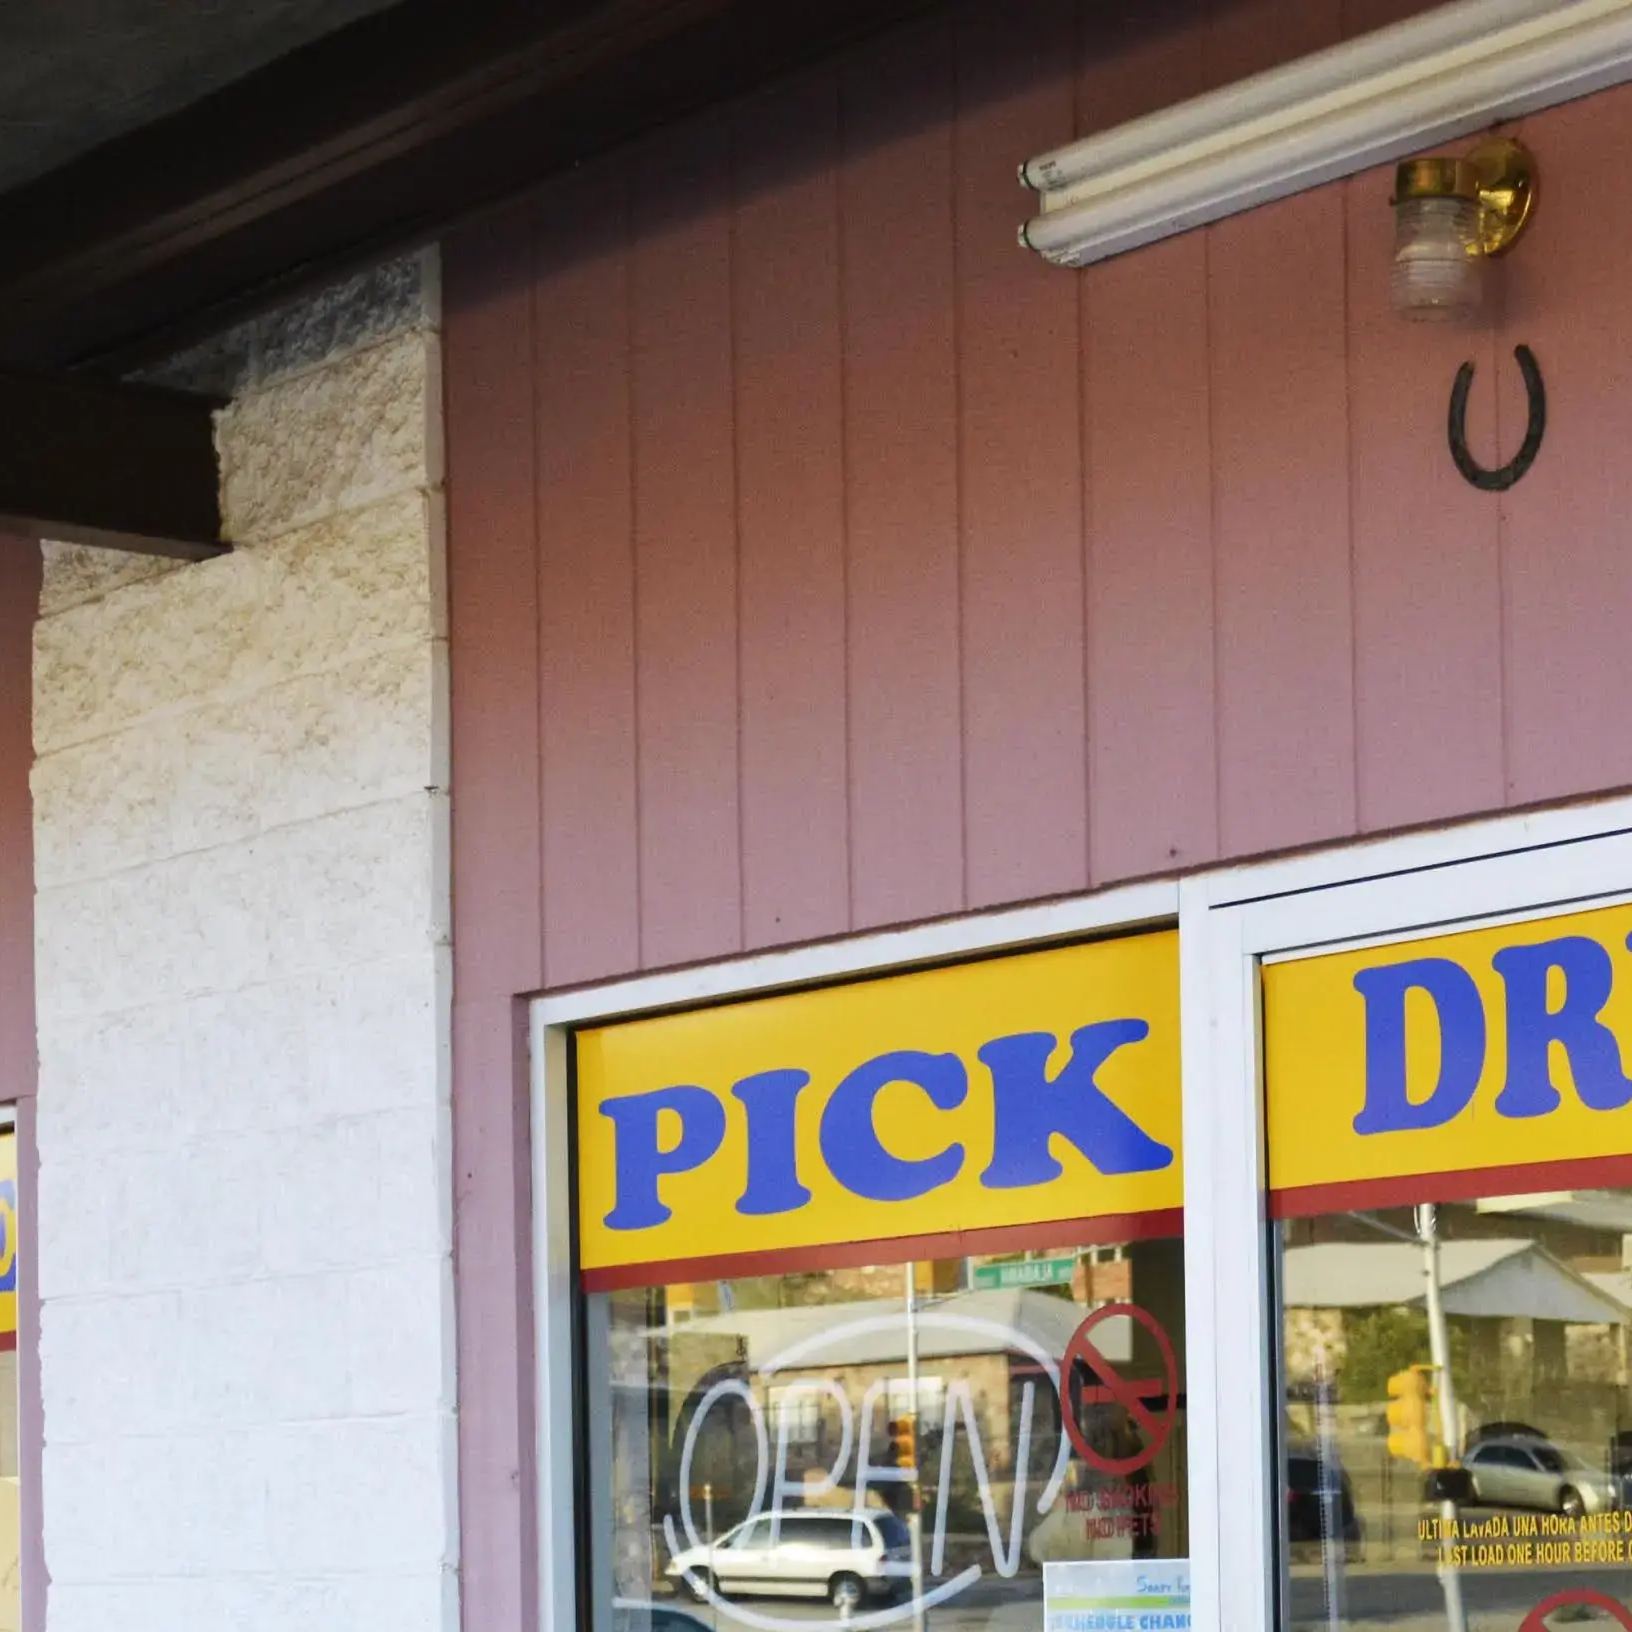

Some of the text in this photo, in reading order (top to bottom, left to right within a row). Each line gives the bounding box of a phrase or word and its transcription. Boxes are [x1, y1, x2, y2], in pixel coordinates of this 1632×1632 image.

[598, 1018, 1173, 1231] PICK
[680, 1378, 1034, 1578] OPEN
[1513, 1515, 1538, 1536] UNA
[1541, 1513, 1575, 1536] HORA
[1579, 1511, 1619, 1534] ANTES
[1438, 1543, 1466, 1567] LAST
[1471, 1543, 1504, 1566] LOAD
[1507, 1542, 1533, 1565] ONE
[1536, 1541, 1570, 1563] HOUR
[1575, 1540, 1624, 1563] BEFORE
[1139, 1613, 1191, 1631] CHAN
